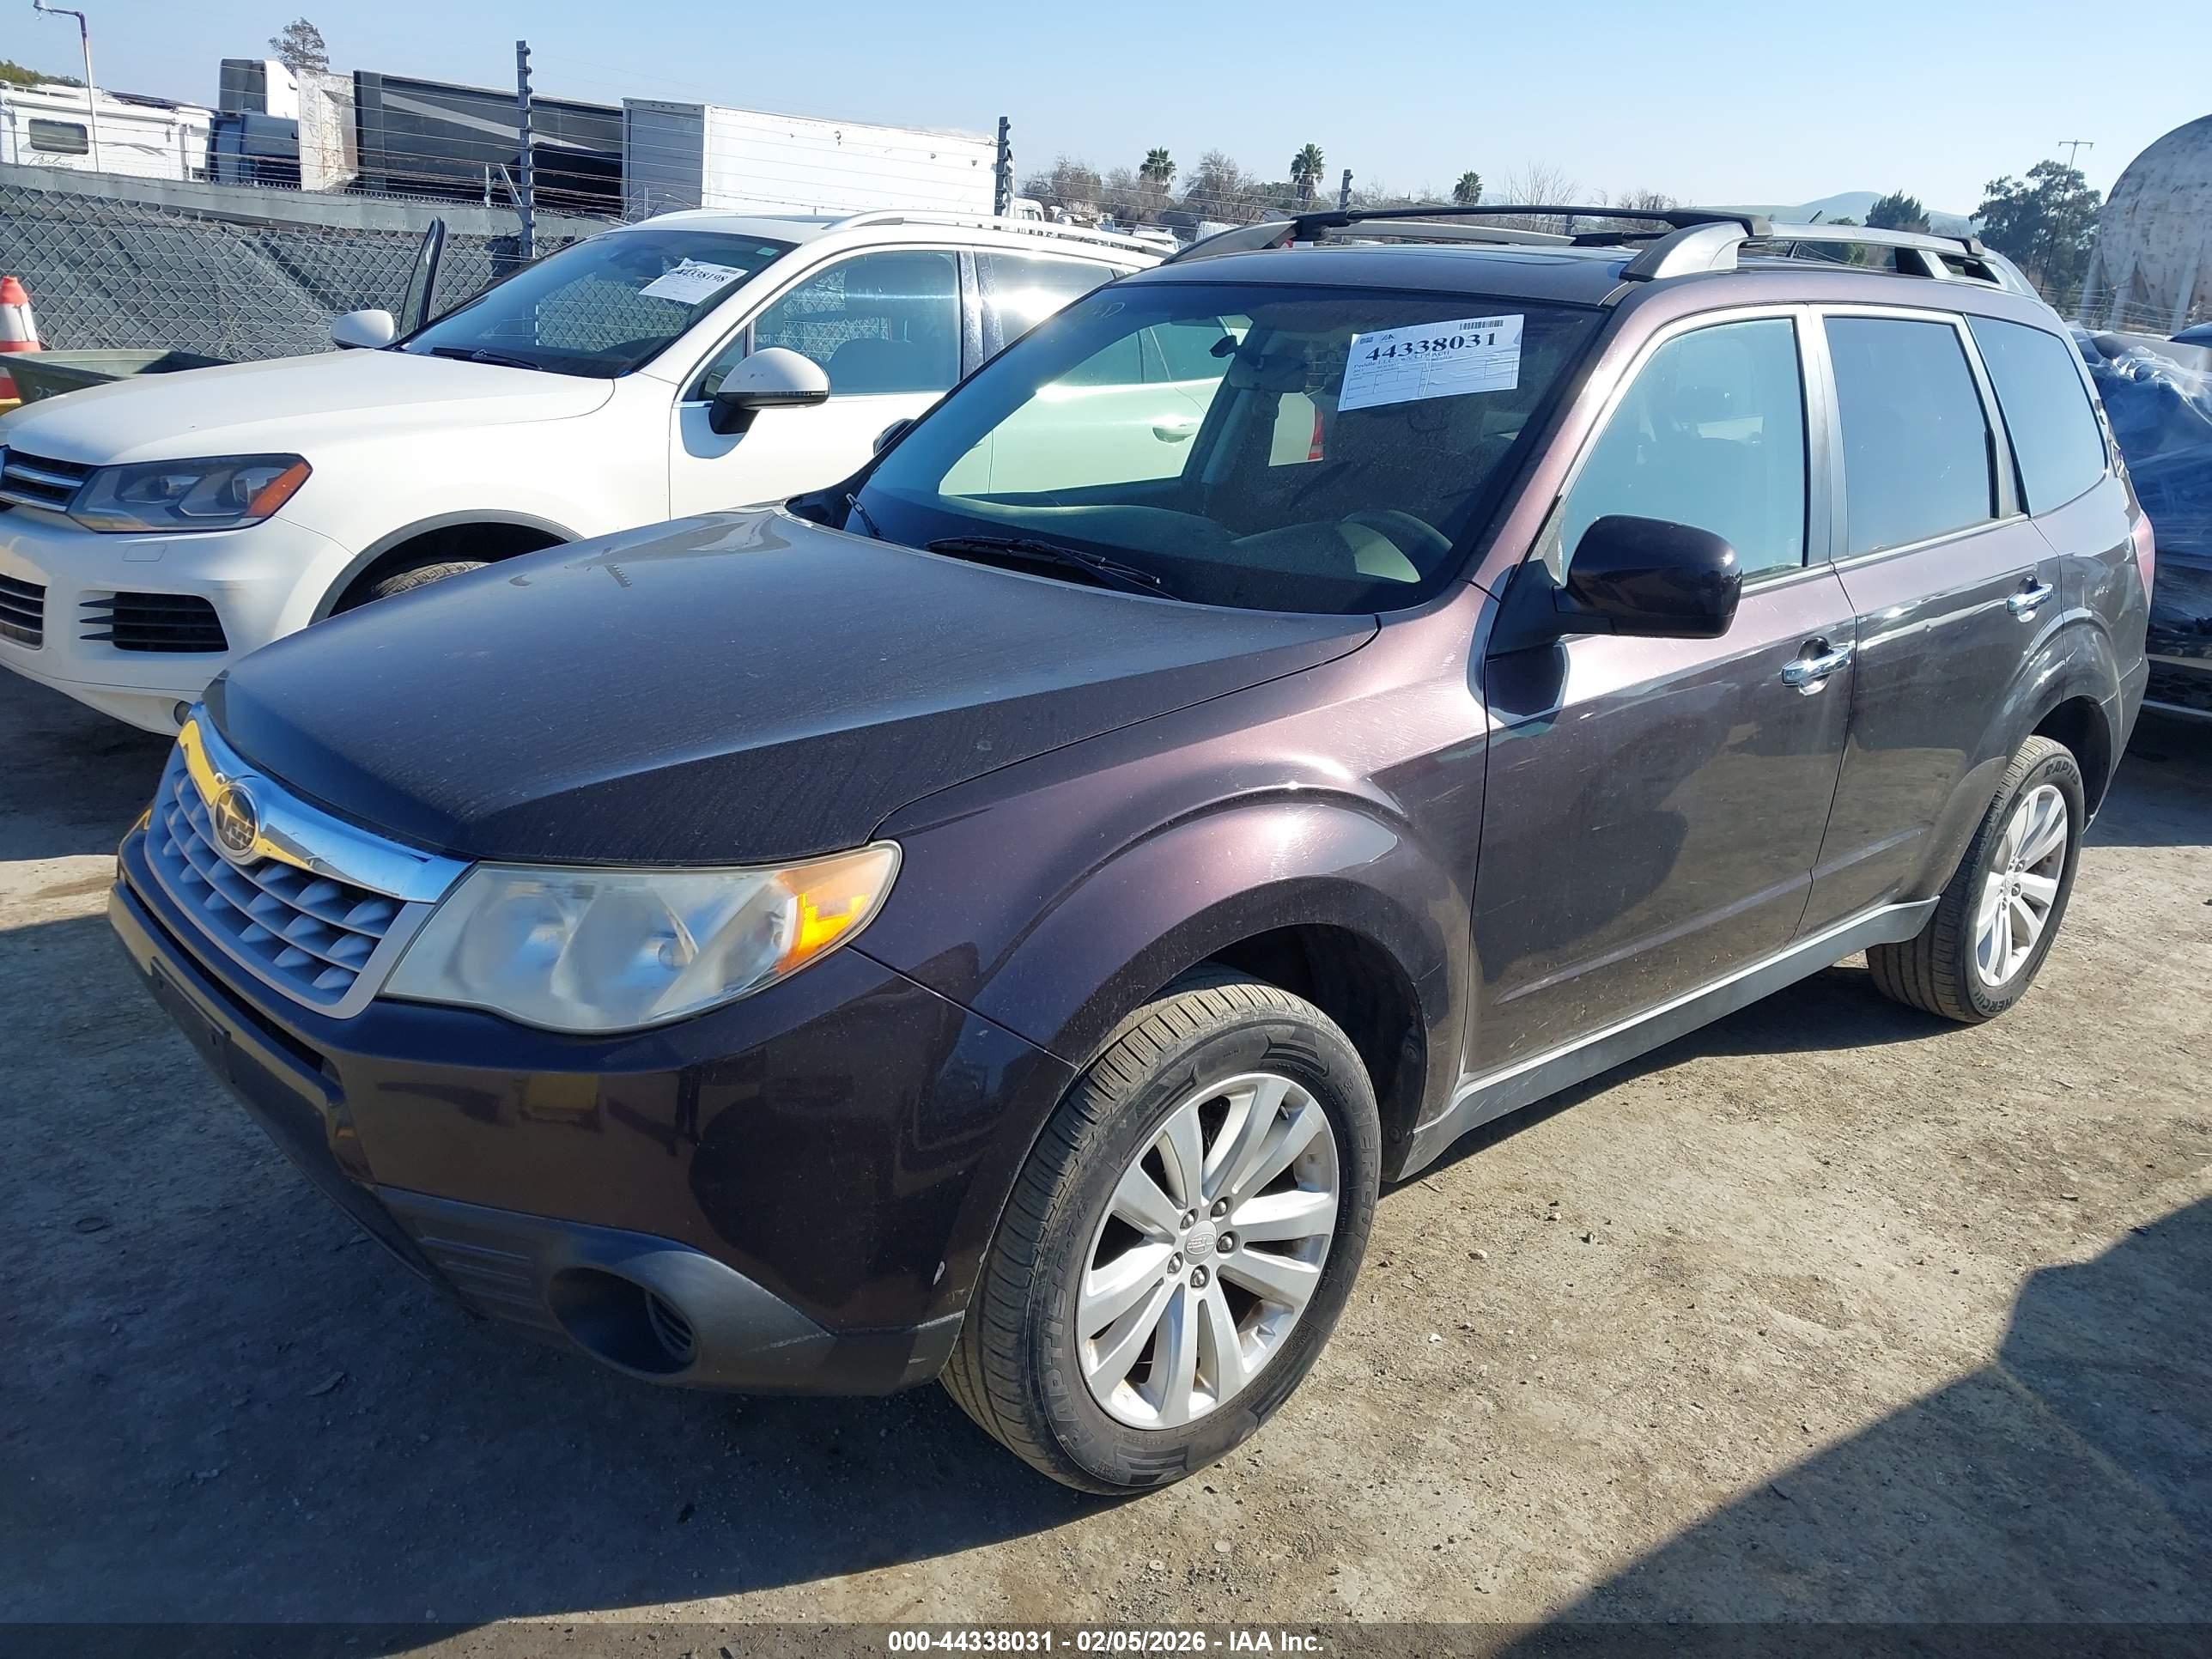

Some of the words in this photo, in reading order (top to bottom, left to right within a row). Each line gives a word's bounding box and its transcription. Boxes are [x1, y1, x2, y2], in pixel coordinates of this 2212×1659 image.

[1364, 332, 1498, 361] 44338031
[2044, 761, 2080, 786] RAPTIS
[1042, 1278, 1095, 1451] RAPTIS
